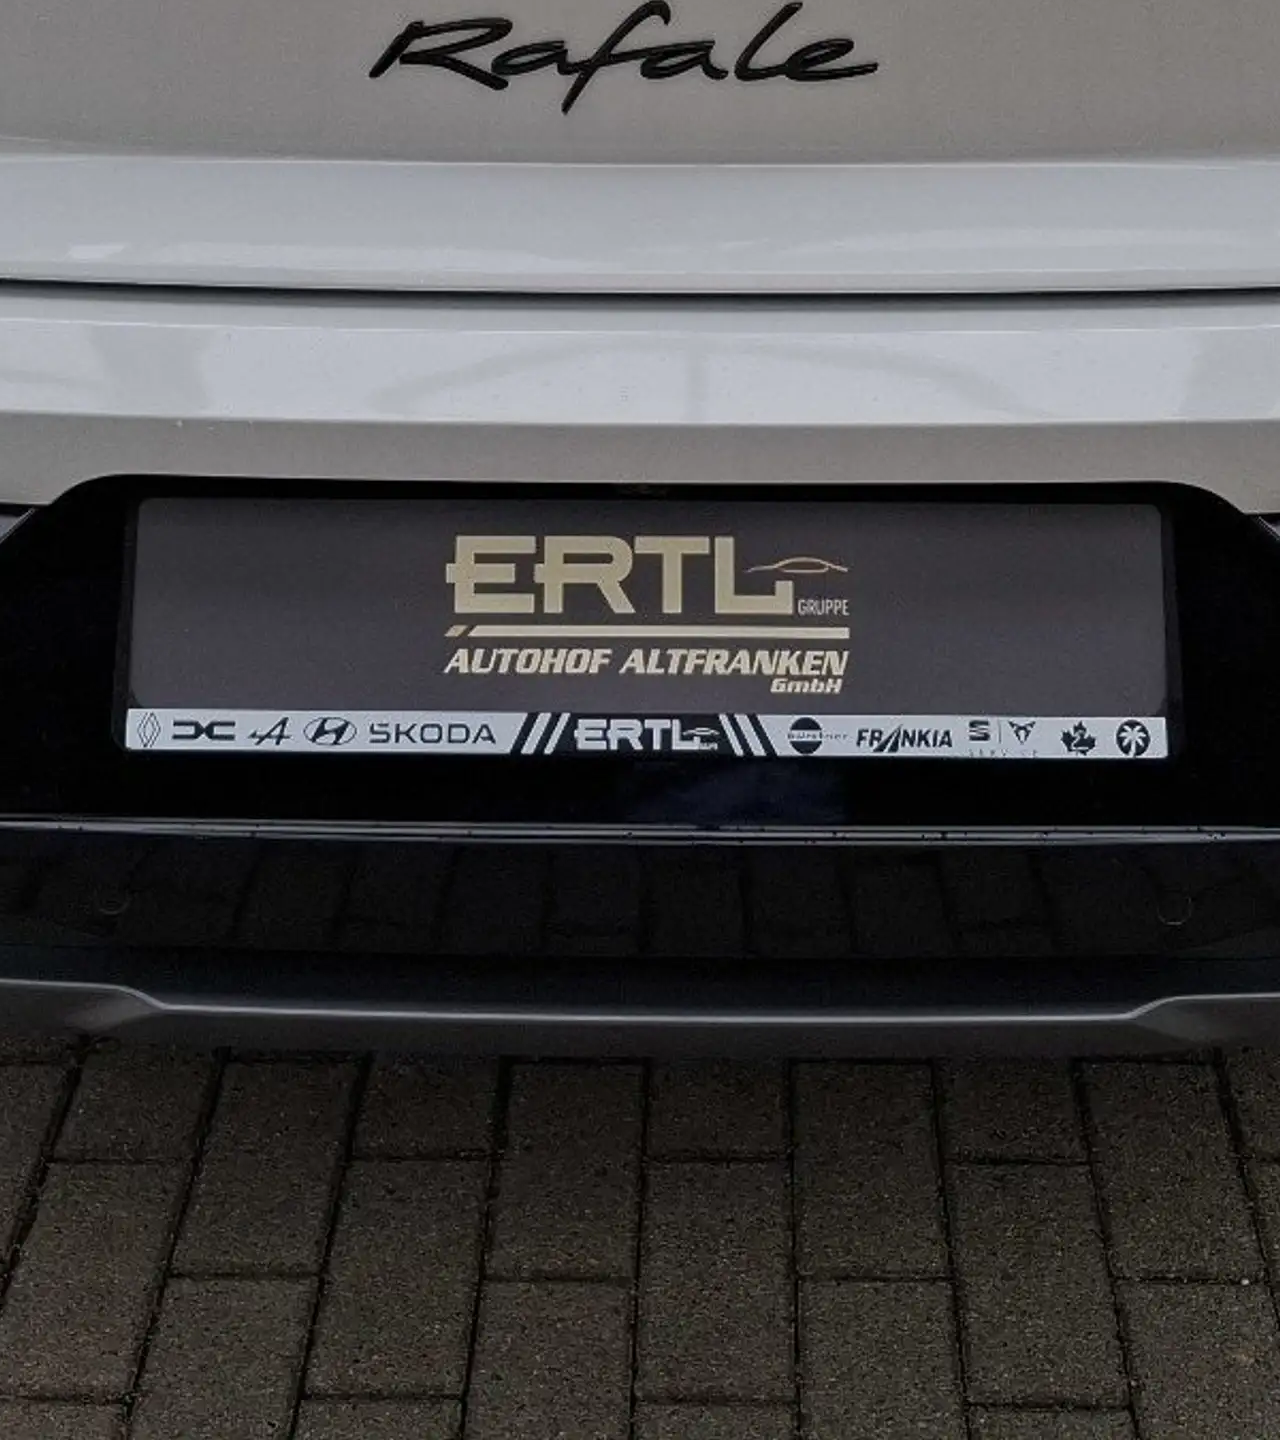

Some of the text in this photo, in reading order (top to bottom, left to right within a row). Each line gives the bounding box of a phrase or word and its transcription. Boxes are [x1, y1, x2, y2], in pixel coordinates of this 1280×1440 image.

[368, 0, 878, 115] Rafale
[445, 535, 851, 617] ERTL GRUPPE
[443, 647, 851, 677] AUTOHOF ALTFRANKEN
[770, 677, 843, 695] GmbH
[574, 718, 701, 751] ERTL
